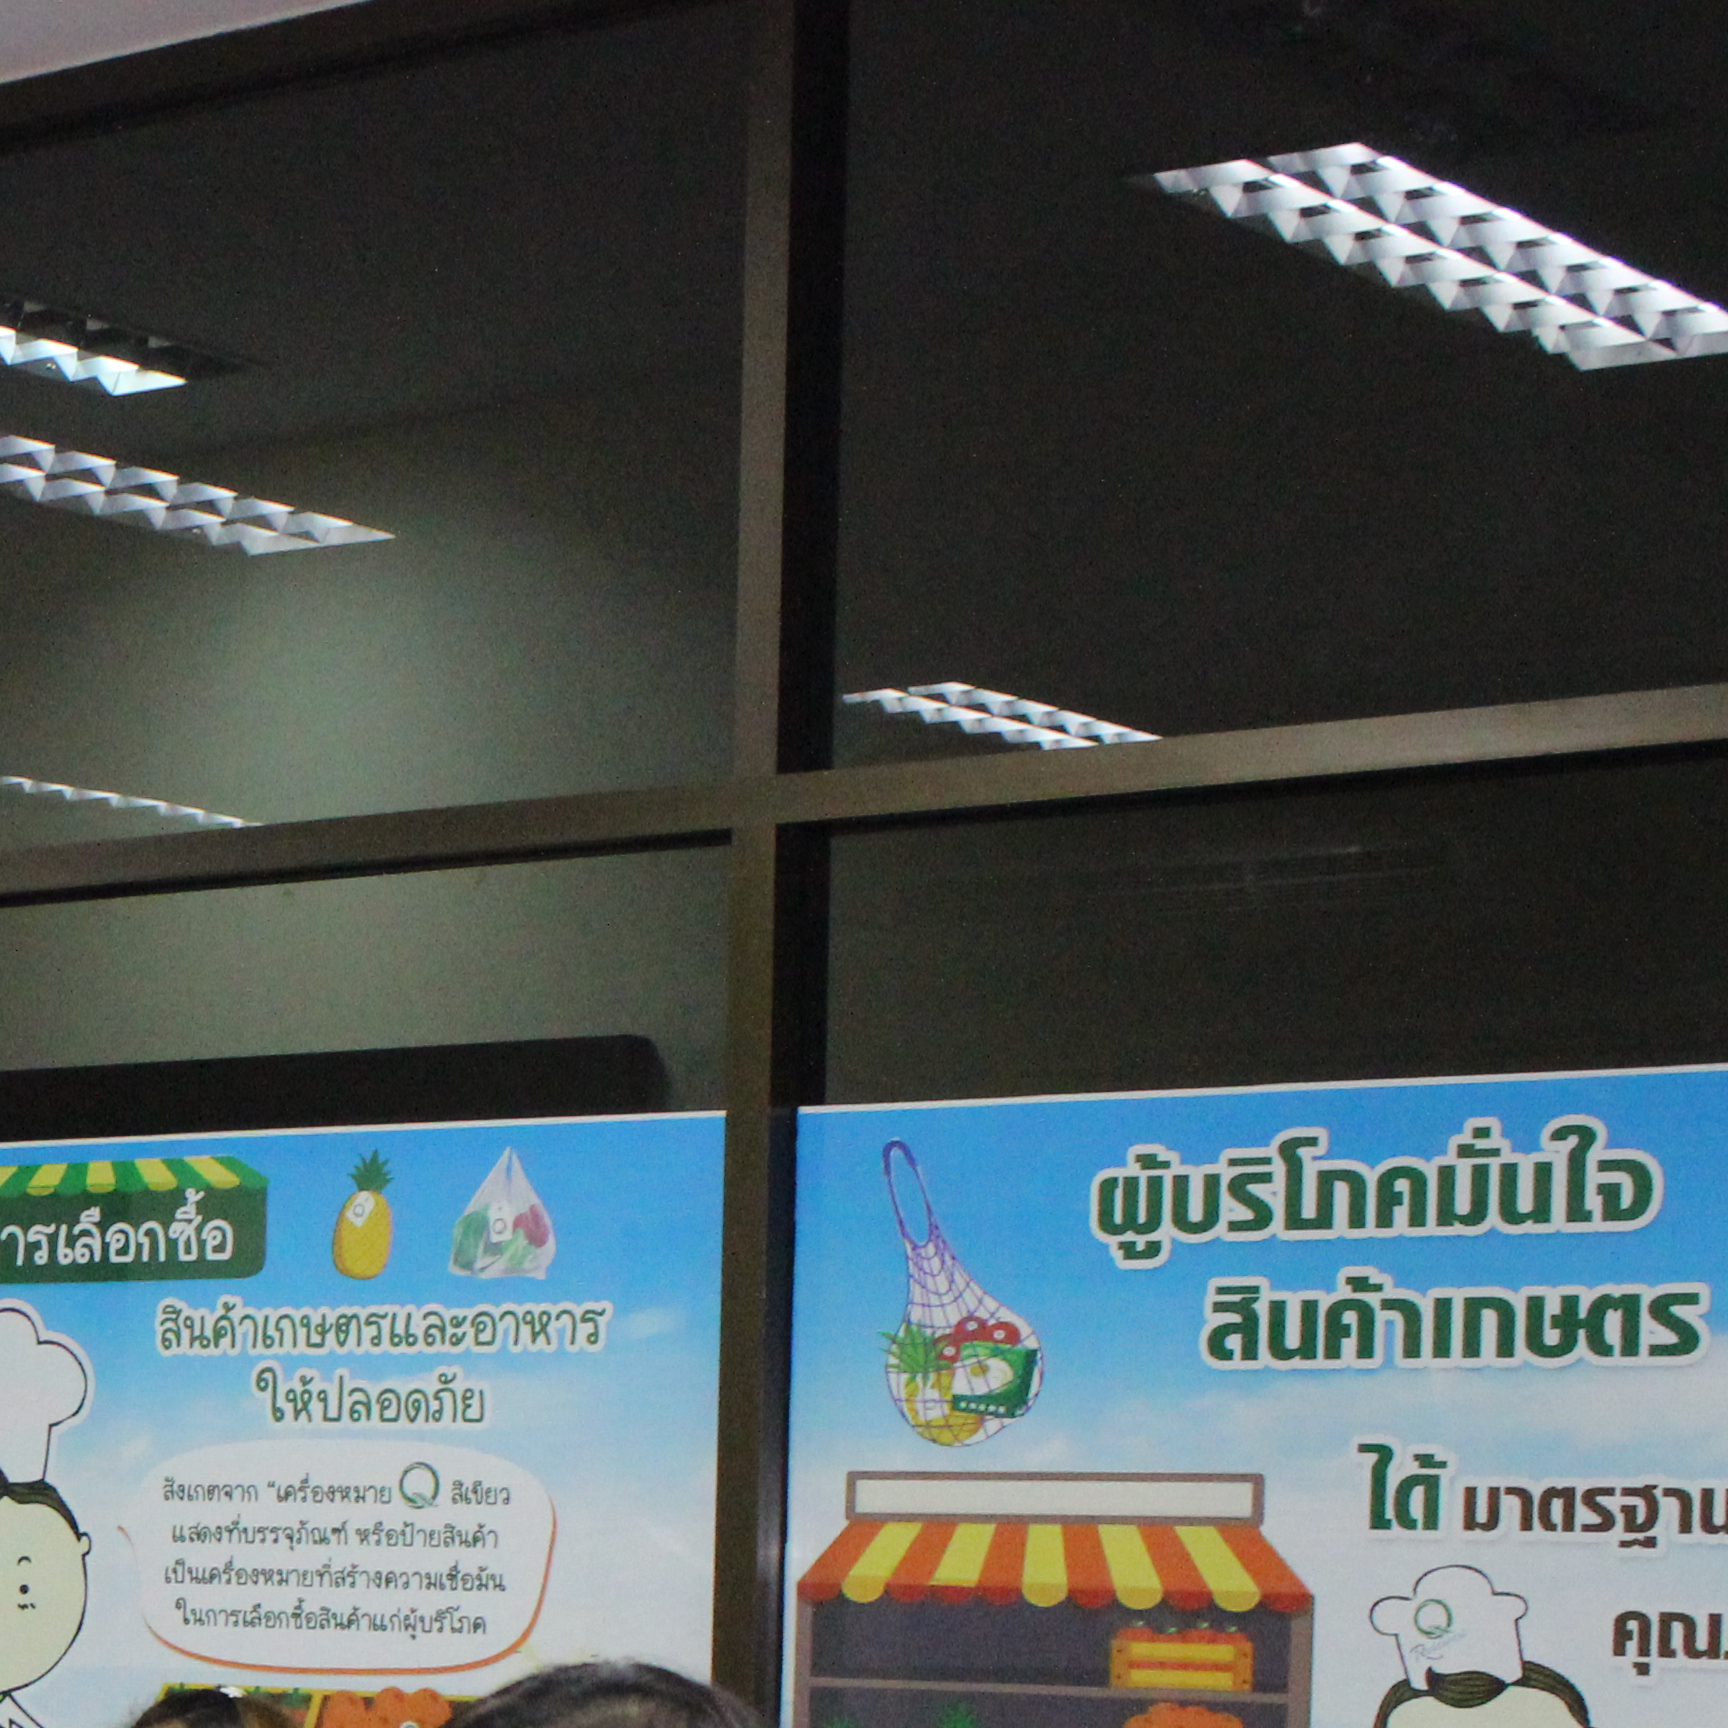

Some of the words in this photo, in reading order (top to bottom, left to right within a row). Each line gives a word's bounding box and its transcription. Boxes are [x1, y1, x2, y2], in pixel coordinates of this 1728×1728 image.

[1096, 1124, 1655, 1262] ผู้บริโภคมั่นใจ
[159, 1301, 609, 1350] สินค้าเกษตรและอาหาร
[1205, 1276, 1702, 1362] สินค้าเกษตร
[255, 1365, 486, 1424] ให้ปลอดภัย
[162, 1476, 259, 1502] สังเกตจาก
[1357, 1443, 1448, 1532] ได้
[1612, 1609, 1728, 1677] คุณ
